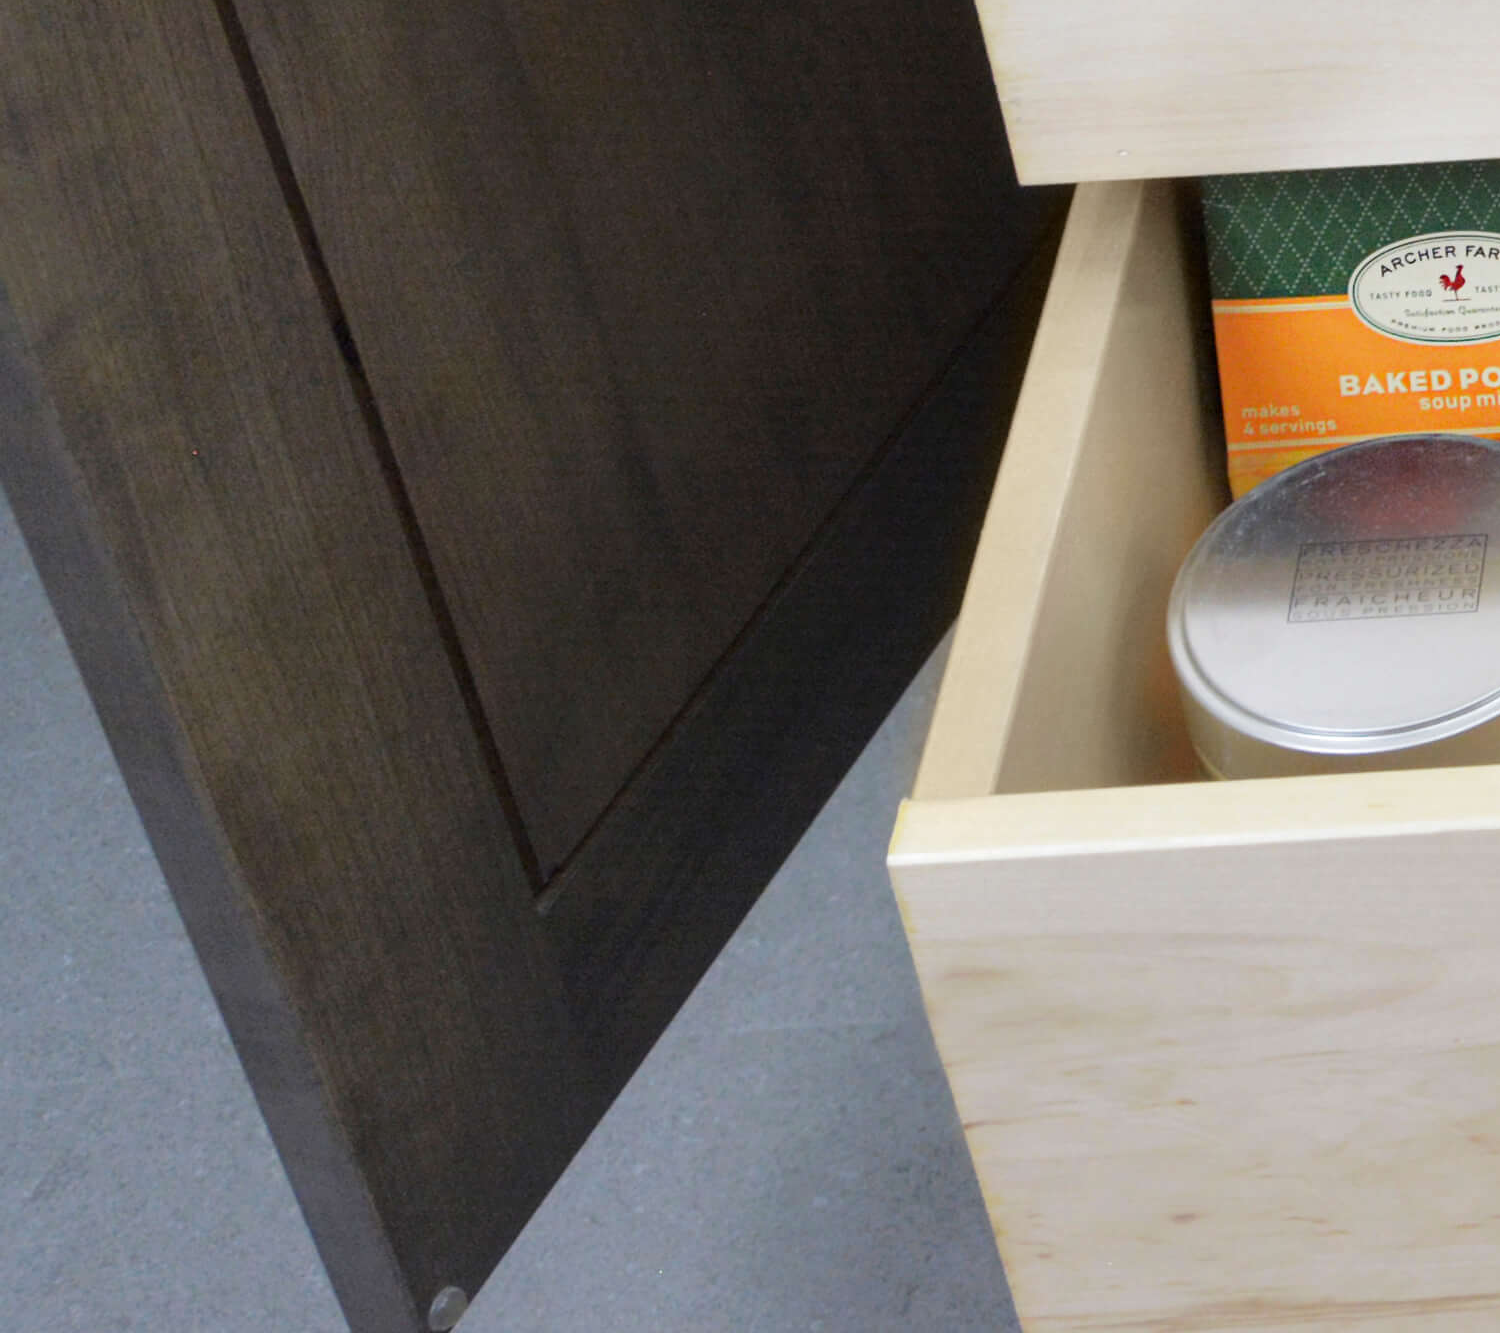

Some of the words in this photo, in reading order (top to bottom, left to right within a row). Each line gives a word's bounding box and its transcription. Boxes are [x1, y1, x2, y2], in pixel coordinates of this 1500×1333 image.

[1380, 245, 1457, 277] ARCHER
[1369, 290, 1401, 301] TASTY
[1338, 369, 1452, 397] BAKED
[1241, 403, 1300, 419] makes
[1418, 392, 1472, 412] soup
[1244, 420, 1255, 435] 4
[1259, 417, 1338, 436] servings
[1299, 563, 1480, 581] PRESSURIZED
